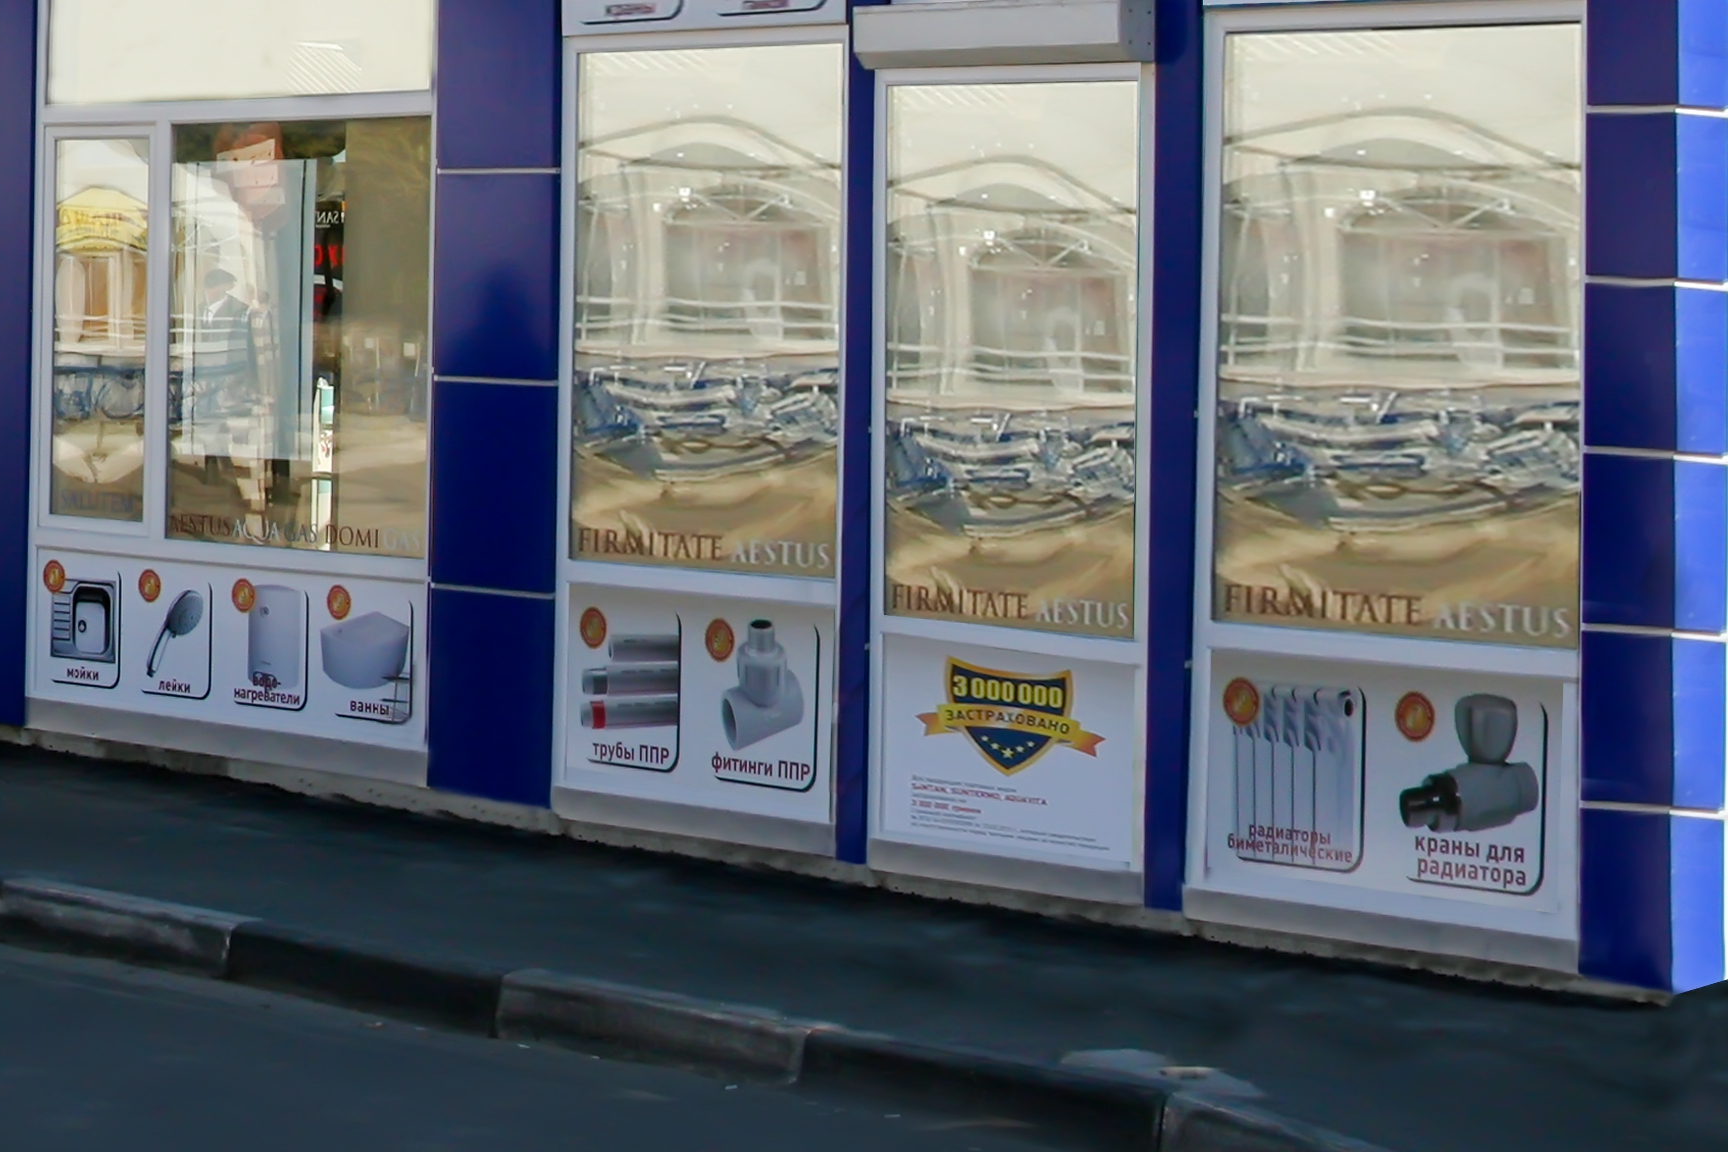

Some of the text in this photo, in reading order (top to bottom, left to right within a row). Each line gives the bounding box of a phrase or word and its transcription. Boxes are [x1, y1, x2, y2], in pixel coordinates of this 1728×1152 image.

[285, 522, 318, 543] GAS
[325, 524, 379, 548] DOMI
[578, 527, 831, 569] FIRMITATE AESTUS
[892, 583, 1130, 630] FIRMITATE AESTUS
[1224, 584, 1571, 638] FIRMITATE AESTUS
[66, 666, 100, 683] мойки
[158, 678, 191, 694] лейки
[233, 687, 301, 708] нагреватели
[952, 674, 1064, 709] 3 000 000
[349, 698, 390, 717] ванны
[945, 708, 1070, 735] ЗАСТРАХОВАНО
[592, 741, 670, 765] трубы ППР
[711, 752, 811, 781] фитинги ППР
[1227, 832, 1354, 865] биметалические
[1248, 823, 1332, 846] радиаторы
[1415, 834, 1525, 864] краны для
[1417, 858, 1527, 889] радиатора
